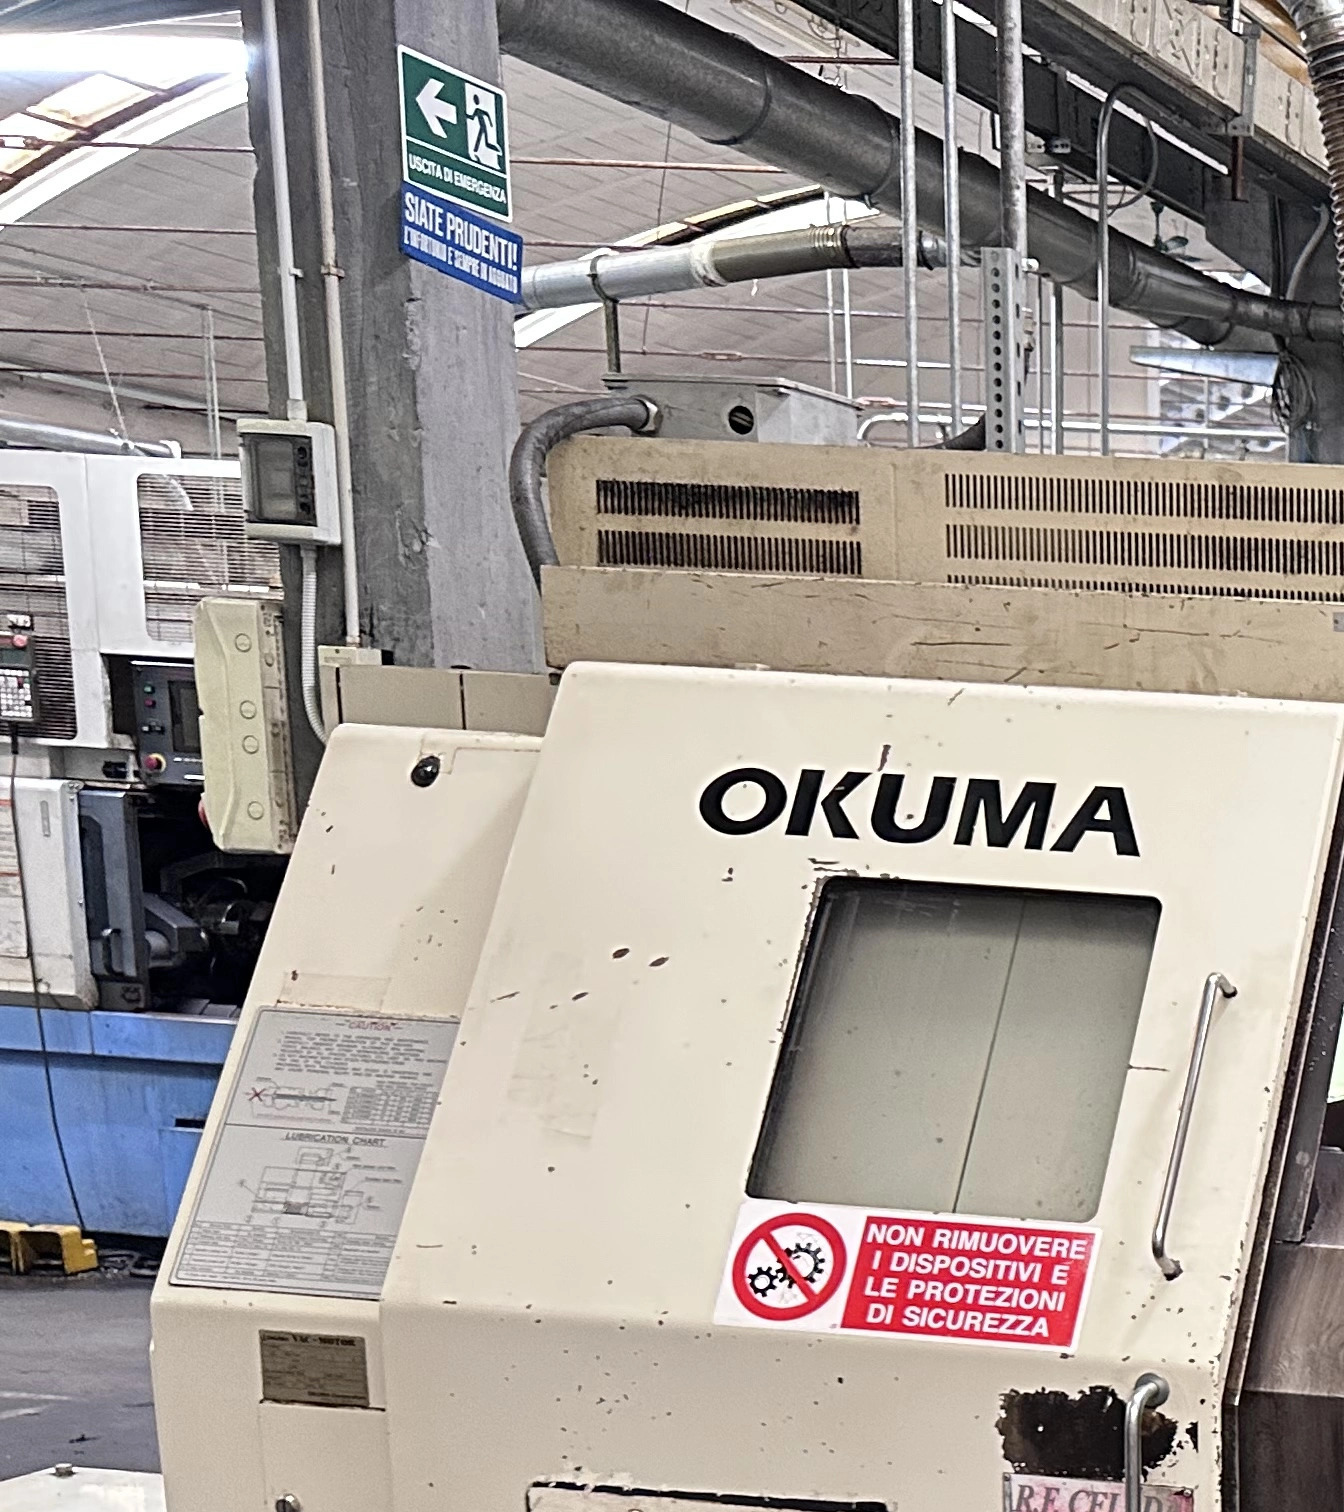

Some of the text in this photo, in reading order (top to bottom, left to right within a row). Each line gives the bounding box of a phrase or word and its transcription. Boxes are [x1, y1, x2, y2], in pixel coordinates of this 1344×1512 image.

[408, 153, 507, 204] USCITA DI EMERGENZA
[404, 191, 518, 271] SIATE PRUDENTI!
[699, 766, 1141, 858] OKUMA
[285, 1132, 386, 1147] LUBRICATION CHART
[866, 1222, 1088, 1260] NON RIMUOVERE
[872, 1248, 1069, 1286] I DISPOSITIVI E
[864, 1276, 1067, 1313] LE PROTEZIONI
[867, 1303, 1049, 1338] DI SICUREZZA
